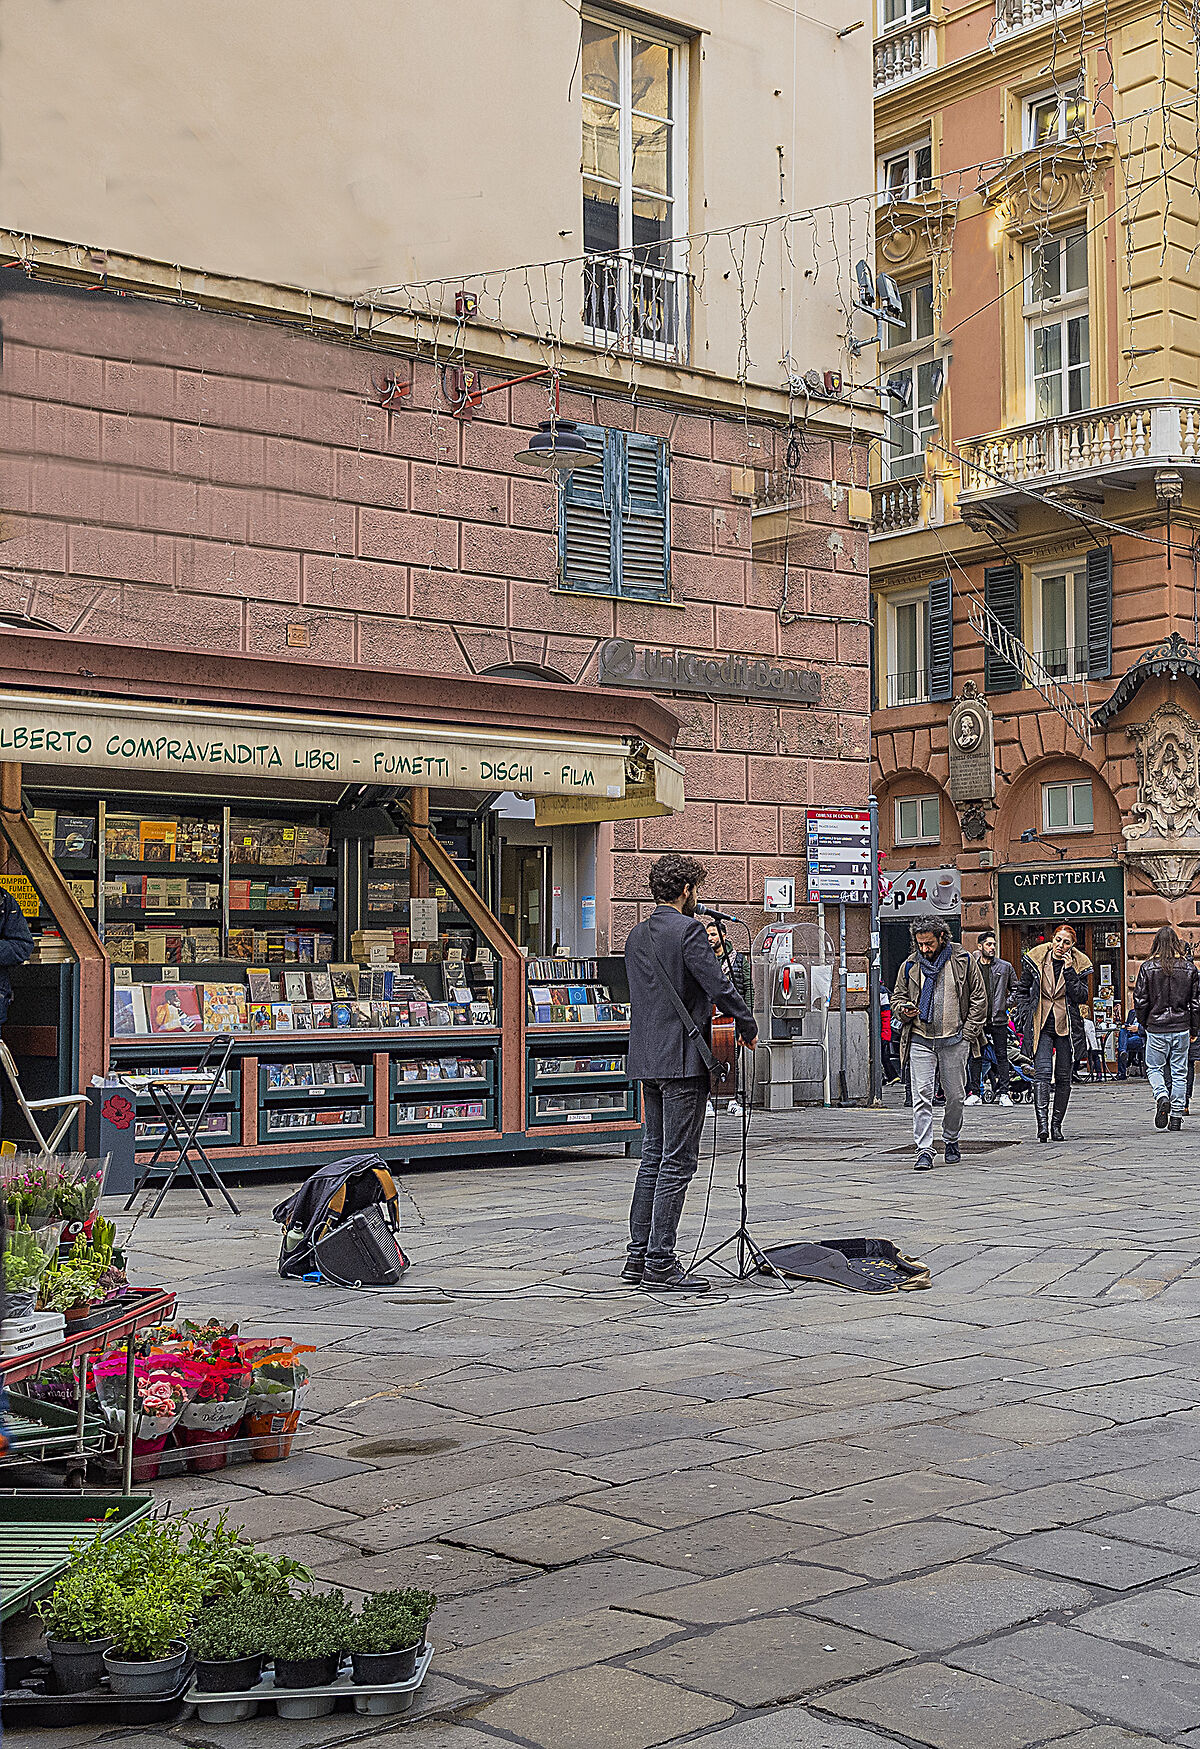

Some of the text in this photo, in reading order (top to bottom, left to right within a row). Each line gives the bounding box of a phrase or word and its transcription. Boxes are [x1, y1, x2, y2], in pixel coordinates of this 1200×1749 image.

[643, 648, 822, 694] UniCredit Banca
[106, 735, 283, 768] COMPRAVENDITA
[294, 749, 340, 771] LIBRI
[373, 752, 449, 778] FUMETTI
[480, 761, 533, 782] DISCHI
[561, 765, 595, 786] FILM
[0, 877, 28, 885] OMPRO
[1014, 870, 1106, 887] CAFFETTERIA
[1003, 898, 1120, 916] BAR BORSA
